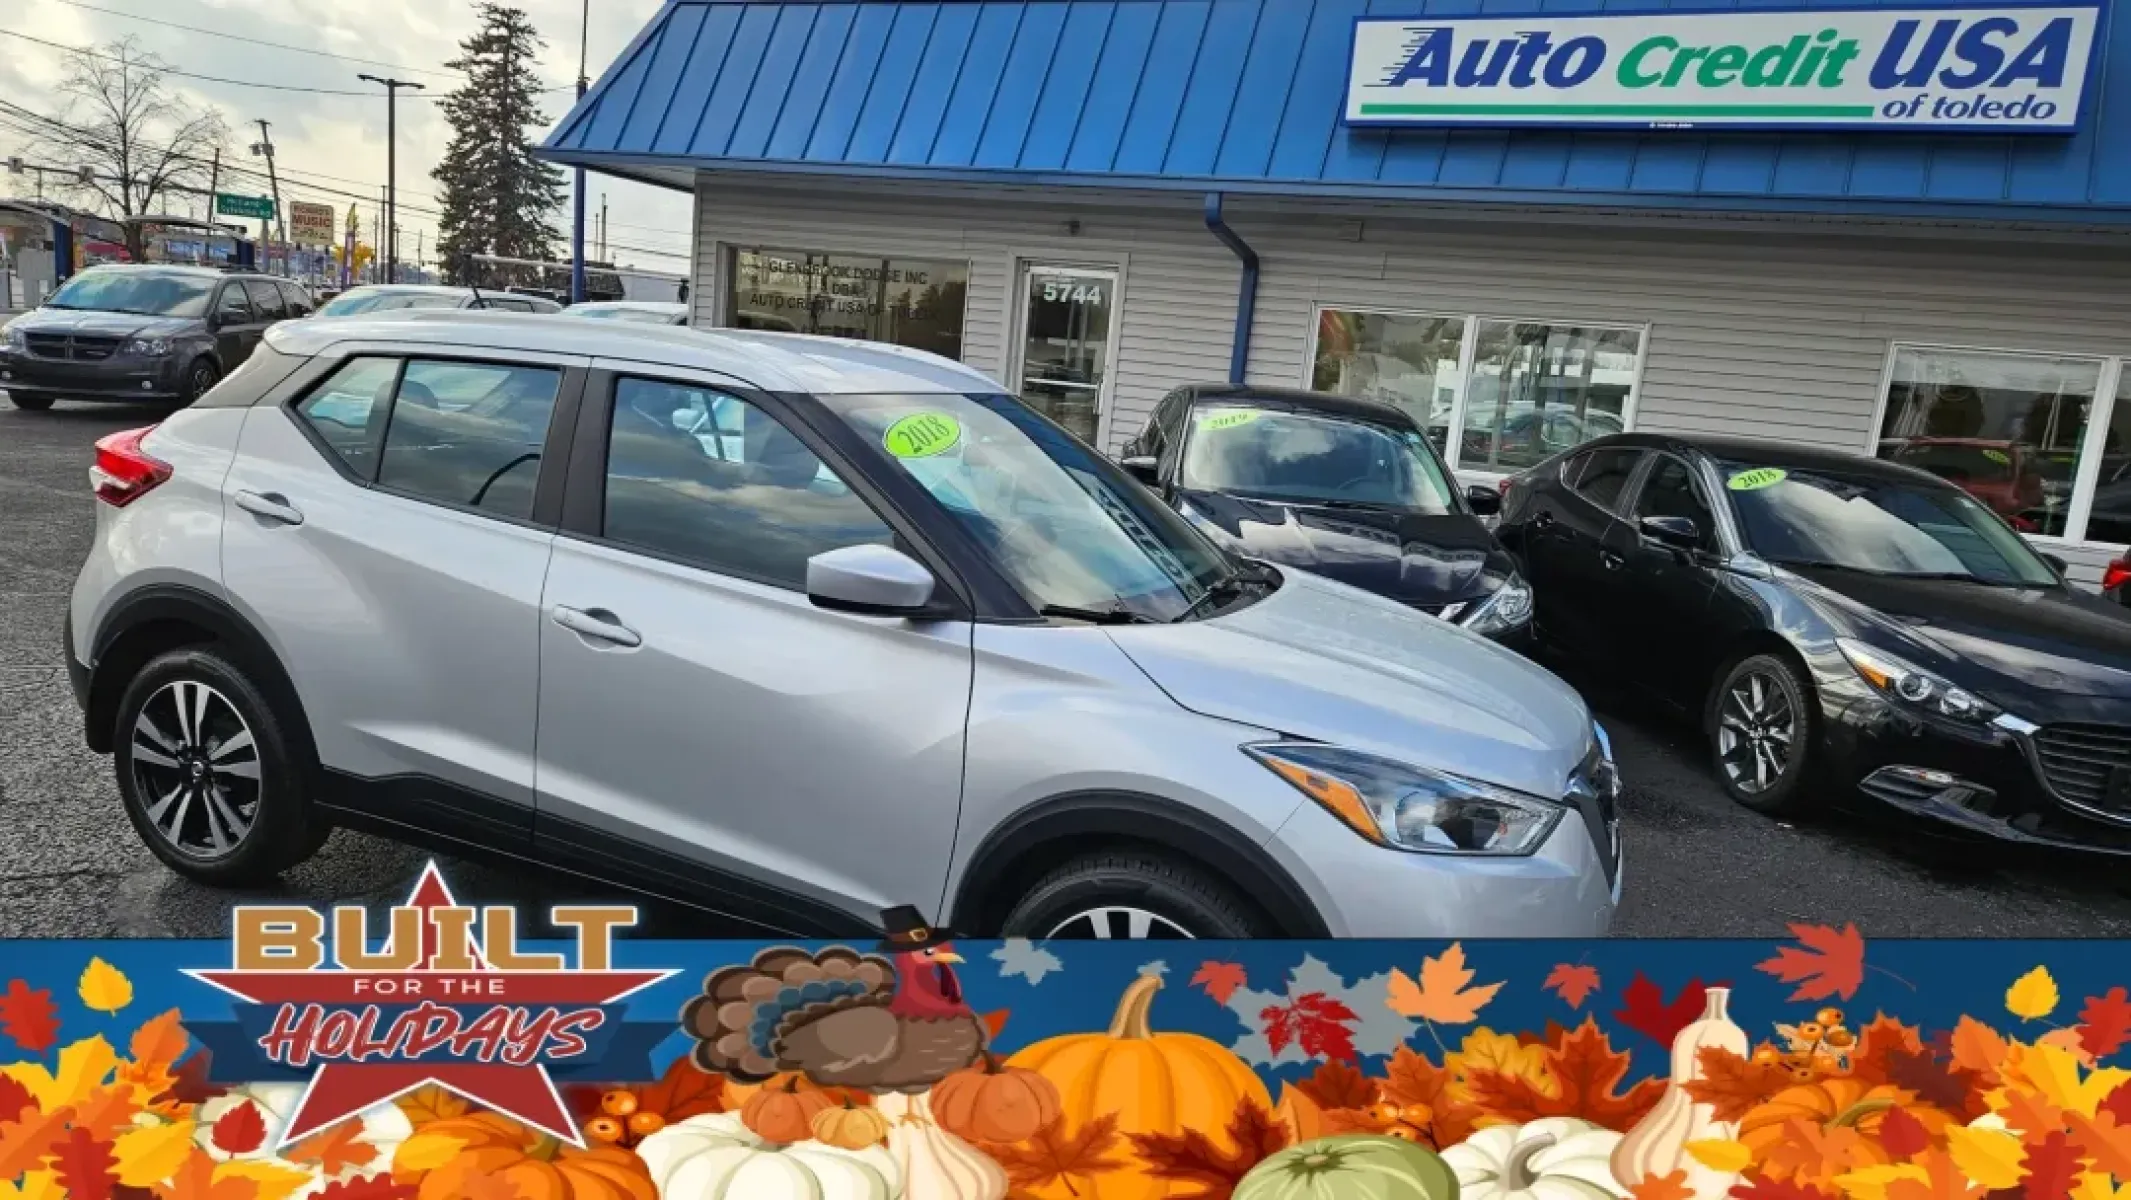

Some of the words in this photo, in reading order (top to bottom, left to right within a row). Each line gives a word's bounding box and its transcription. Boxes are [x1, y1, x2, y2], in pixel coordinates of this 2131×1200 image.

[1382, 27, 1607, 89] Auto
[1616, 29, 1861, 88] Credit
[1868, 17, 2075, 89] USA
[1882, 93, 1929, 118] of
[1931, 94, 2056, 119] toledo
[292, 214, 331, 228] MUSIC
[769, 260, 851, 278] GLENBROOK
[853, 267, 901, 283] DODGE
[905, 269, 928, 285] INC
[750, 293, 784, 308] AUTO
[838, 301, 863, 315] USA
[1043, 282, 1101, 305] 5744
[898, 415, 950, 454] 2018
